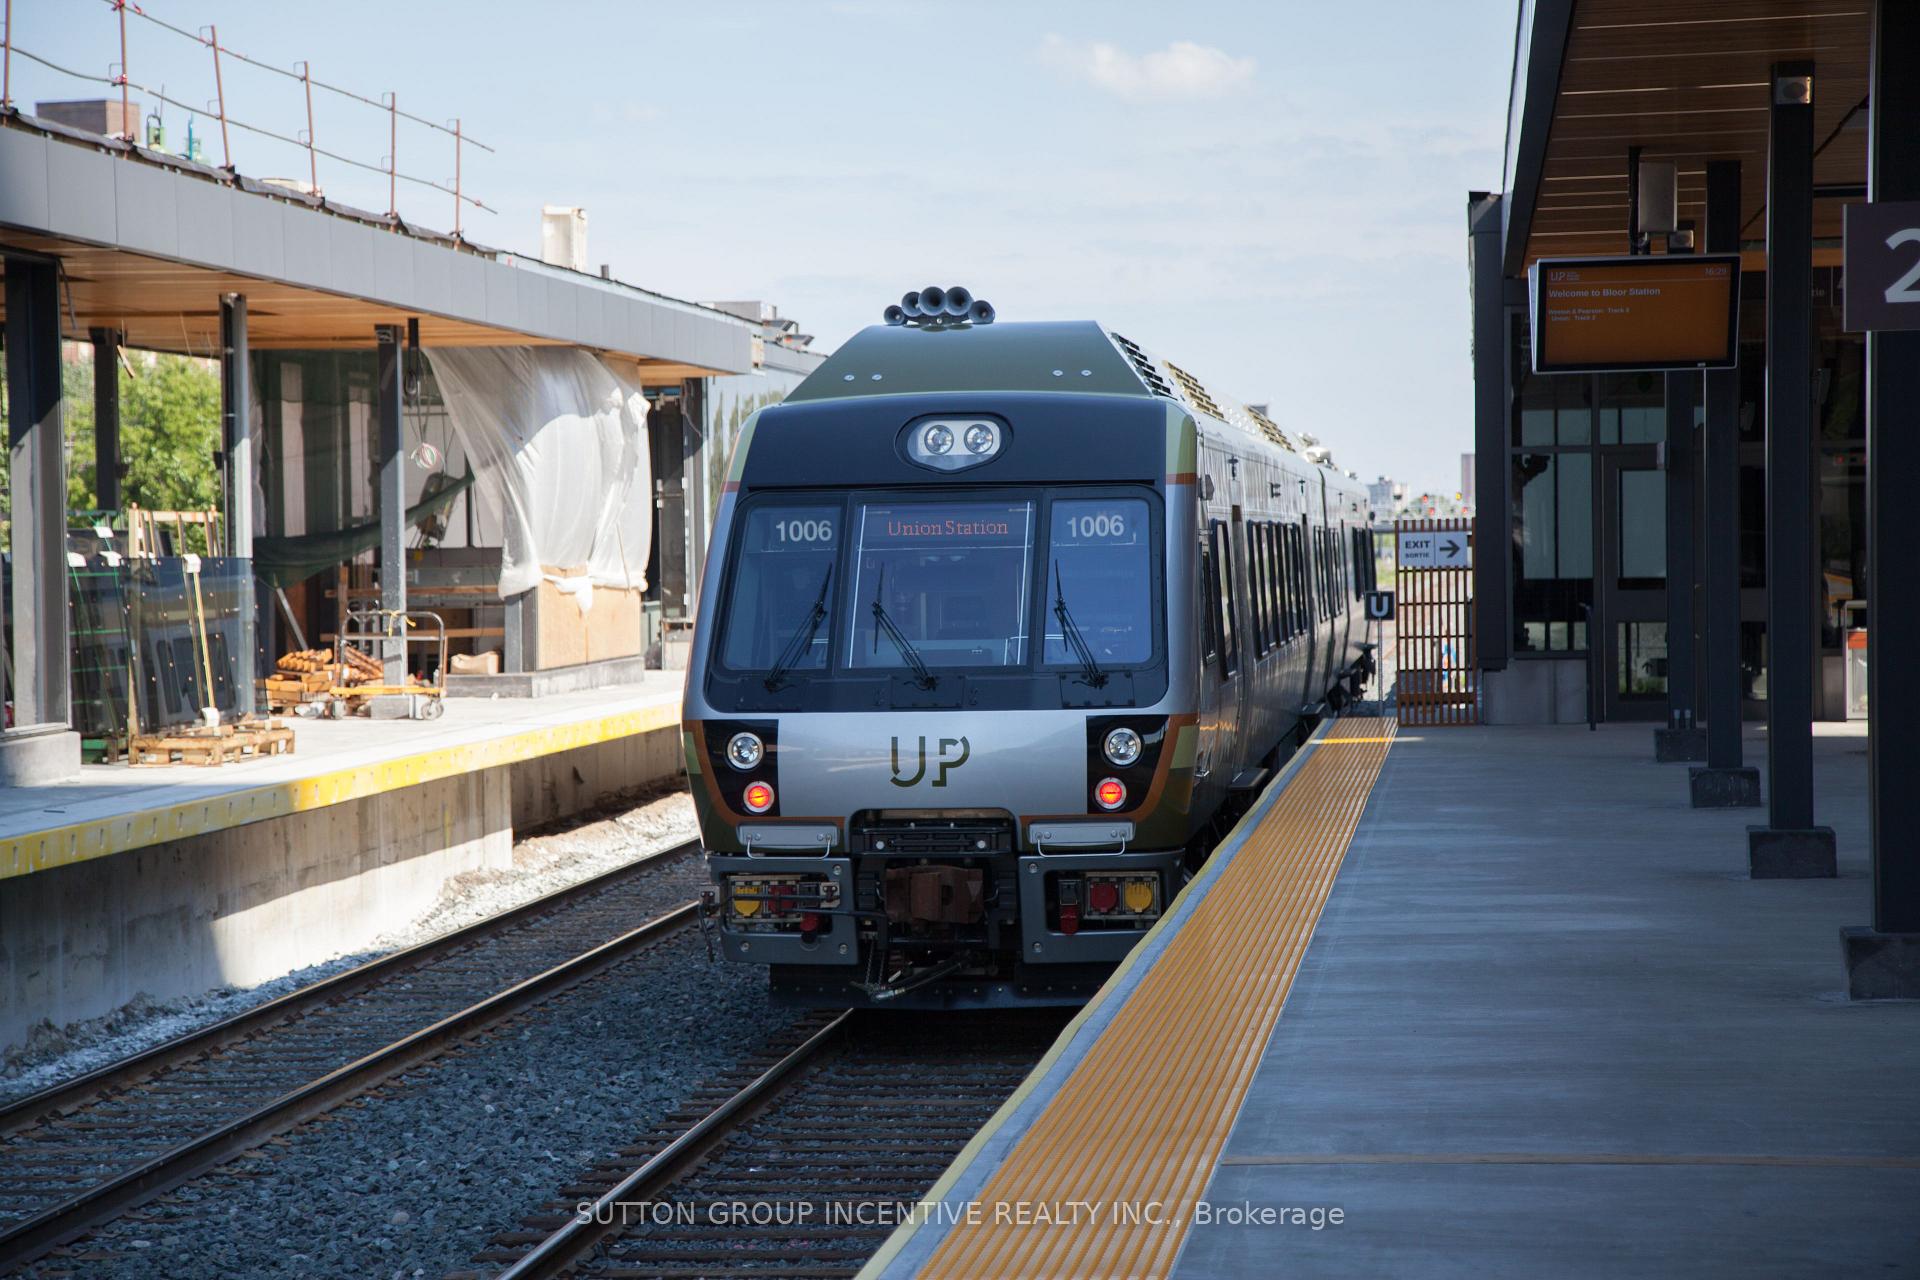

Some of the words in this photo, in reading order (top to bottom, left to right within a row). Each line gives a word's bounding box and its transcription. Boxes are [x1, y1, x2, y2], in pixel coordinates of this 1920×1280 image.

[1884, 228, 1920, 303] 2
[1548, 288, 1589, 298] Welcome
[1592, 287, 1601, 297] to
[1602, 287, 1627, 297] Bloor
[1629, 286, 1661, 296] Station
[776, 520, 833, 542] 1006
[888, 519, 943, 537] Union
[945, 519, 1009, 536] Station
[1066, 514, 1125, 538] 1006
[1405, 540, 1431, 549] EXIT
[1371, 595, 1389, 617] U
[890, 735, 971, 788] UP
